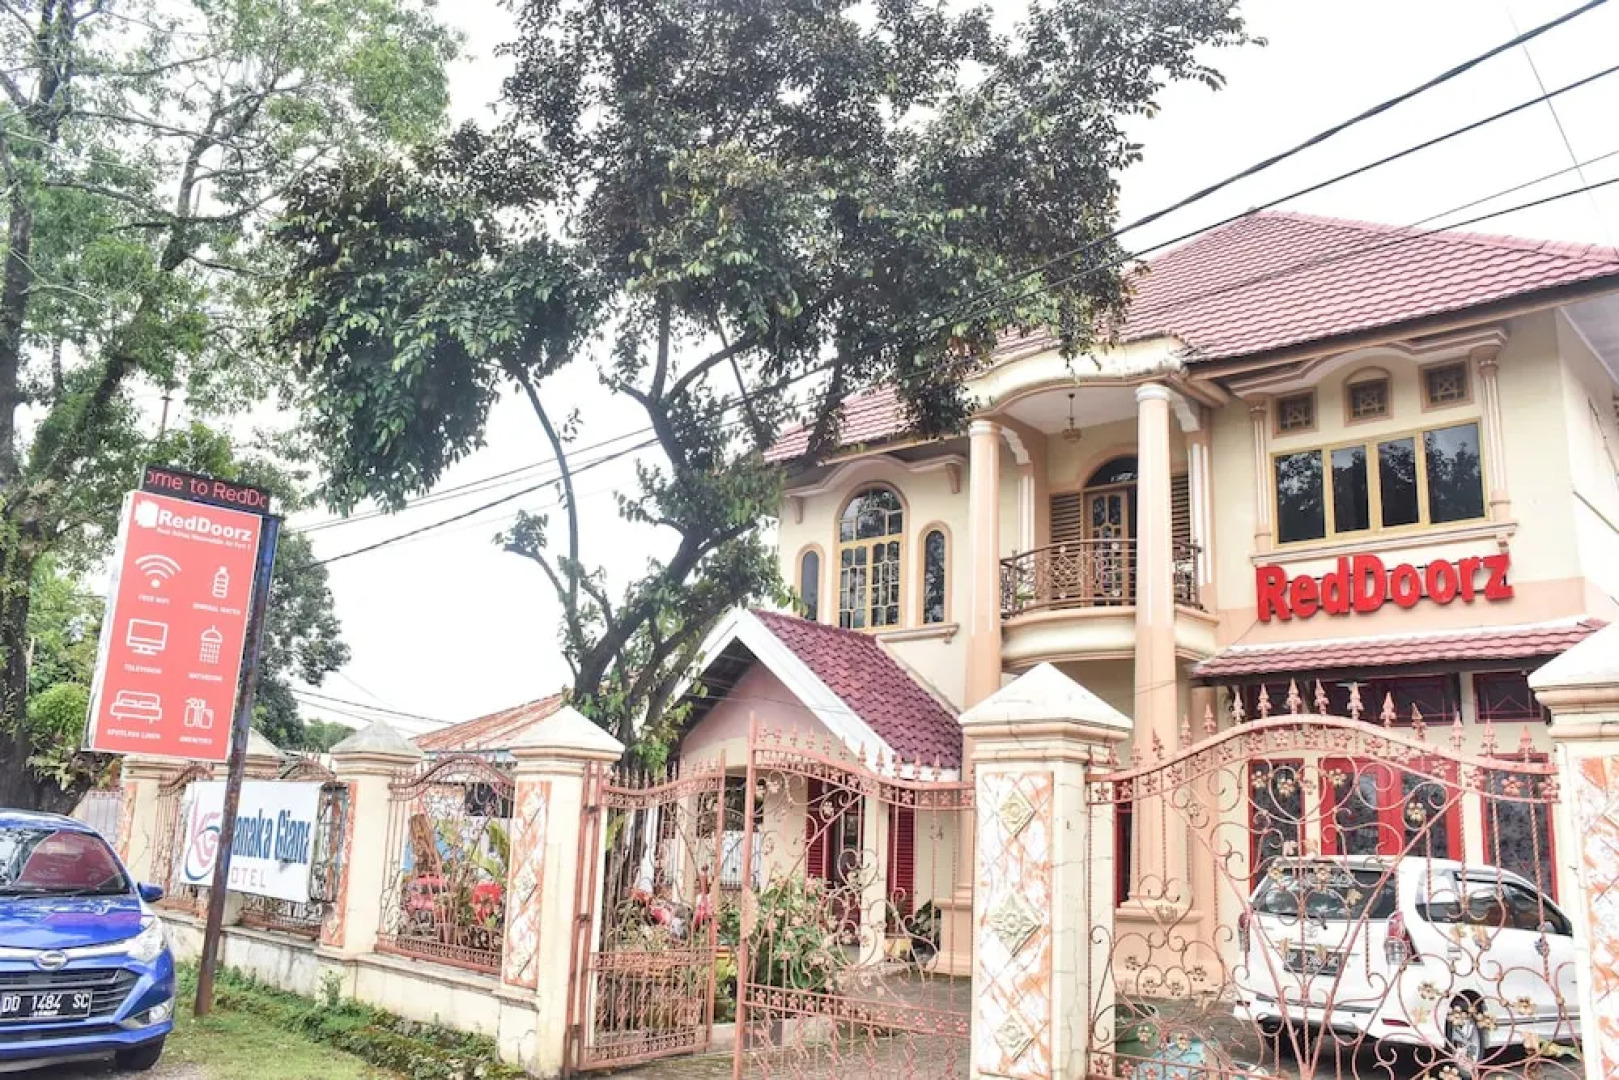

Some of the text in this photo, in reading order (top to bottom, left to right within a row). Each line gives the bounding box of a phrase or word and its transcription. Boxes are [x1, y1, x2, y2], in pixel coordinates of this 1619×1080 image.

[190, 478, 208, 496] to
[158, 509, 253, 541] RedDoorz
[1256, 553, 1515, 622] RedDoorz
[231, 866, 266, 888] OTEL
[2, 993, 90, 1013] DD 1484 SC
